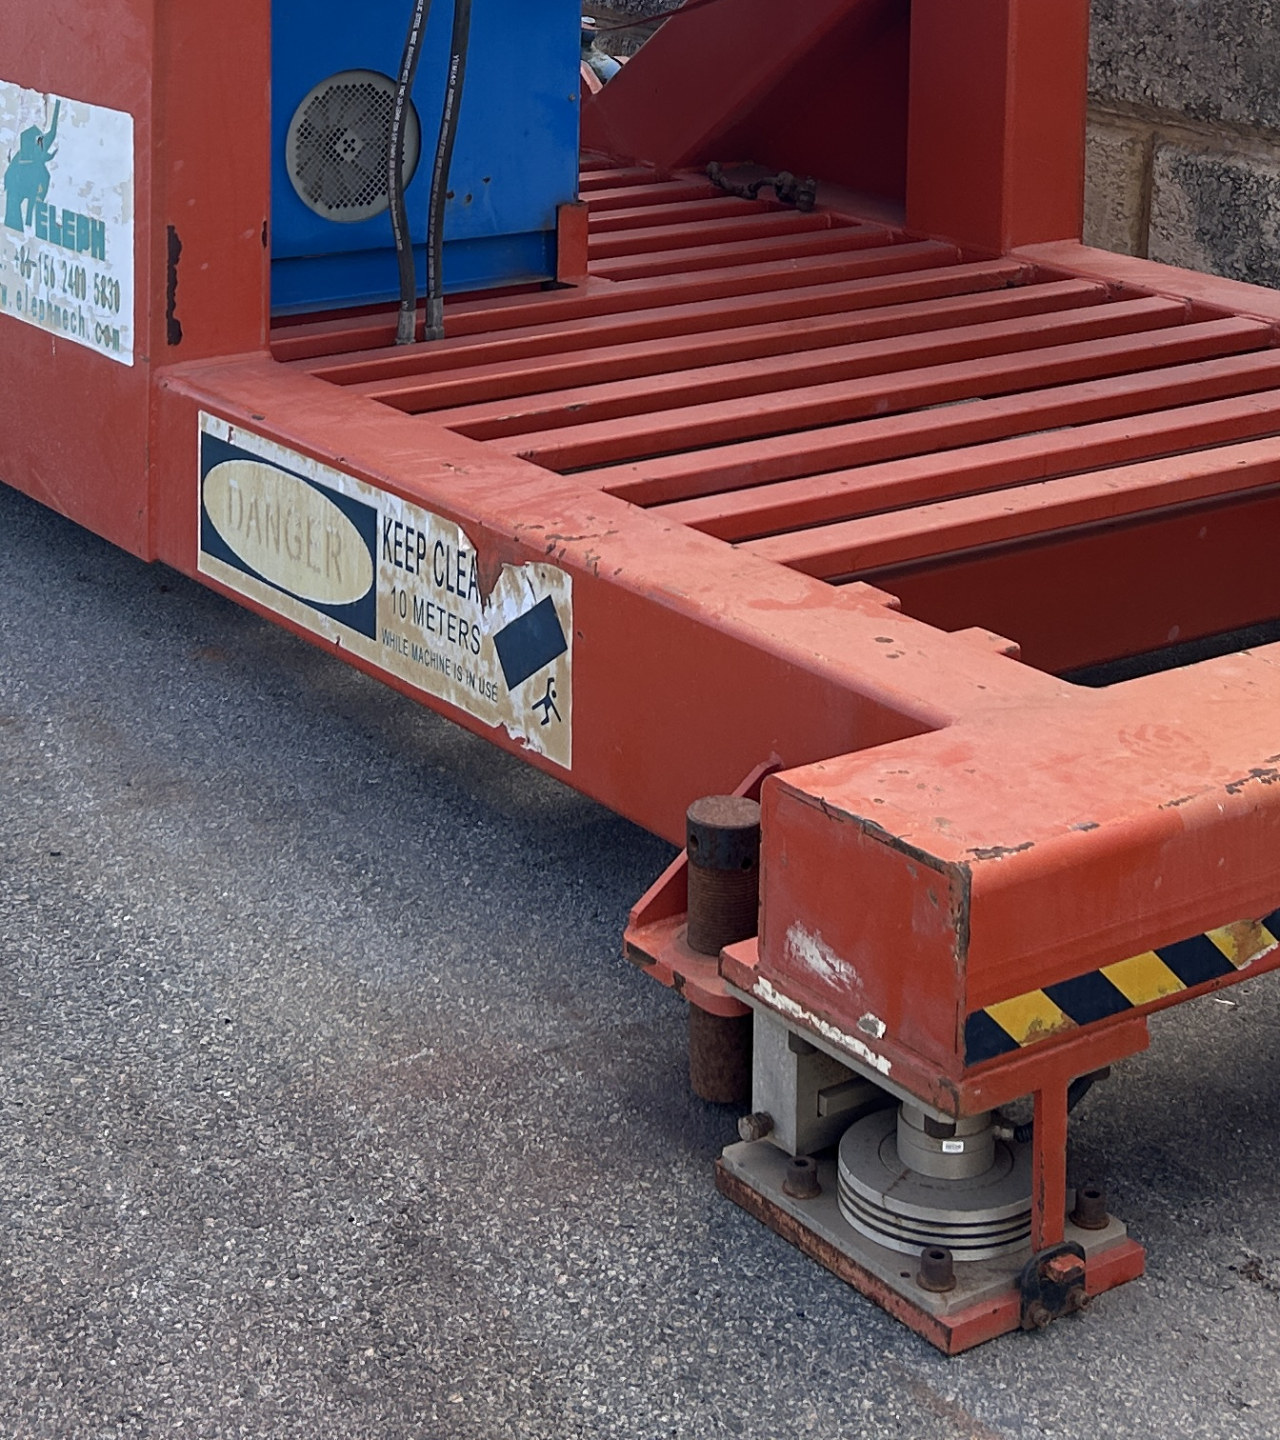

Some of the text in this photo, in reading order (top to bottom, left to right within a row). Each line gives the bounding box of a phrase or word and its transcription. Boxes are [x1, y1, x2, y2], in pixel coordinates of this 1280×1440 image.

[35, 200, 106, 262] ELEPH
[382, 515, 492, 609] KEEP CLEA
[391, 585, 481, 655] 10 METERS
[381, 627, 409, 657] WHILE
[411, 642, 451, 676] MACHINE
[453, 663, 463, 682] IS
[478, 678, 498, 703] USE
